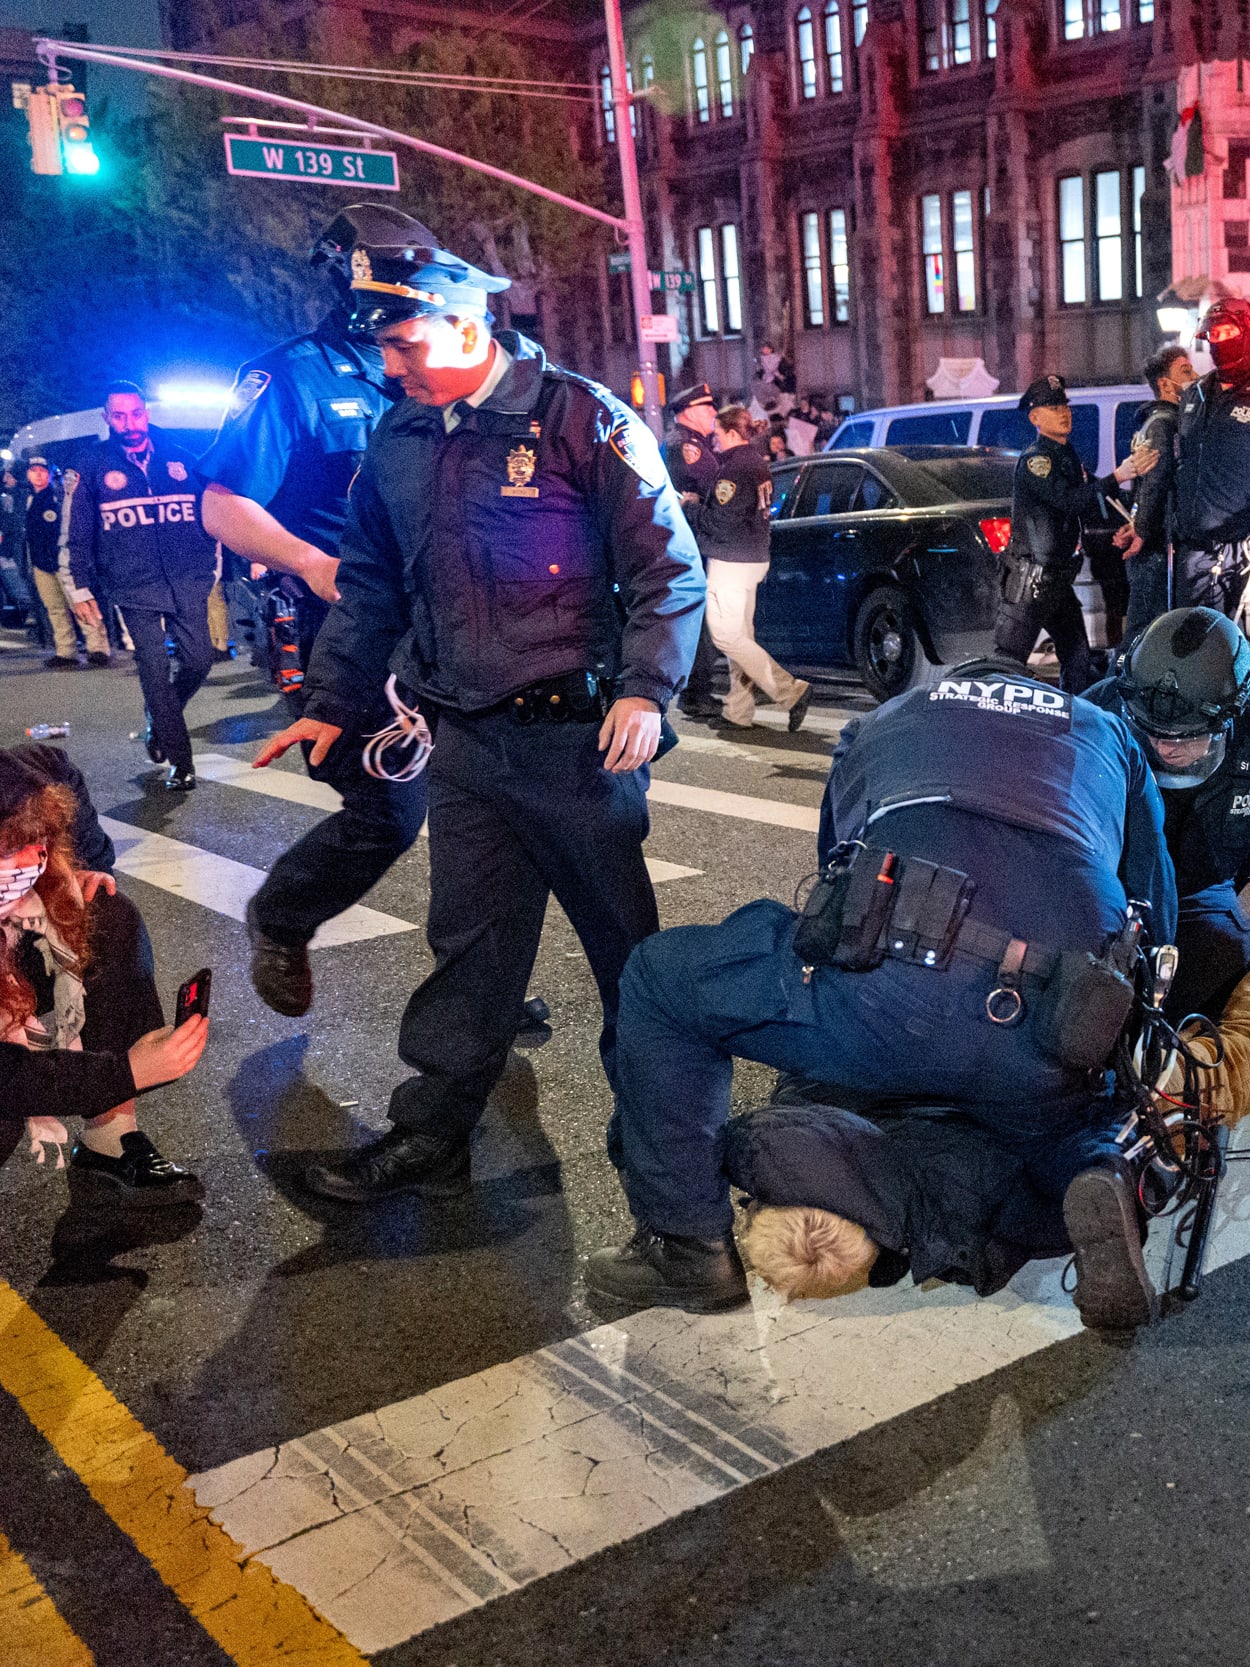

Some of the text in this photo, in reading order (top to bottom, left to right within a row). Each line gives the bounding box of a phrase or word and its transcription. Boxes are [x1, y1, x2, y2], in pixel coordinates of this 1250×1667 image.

[262, 146, 366, 179] W 139 St
[665, 274, 682, 289] 139
[101, 502, 196, 531] POLICE
[929, 692, 1070, 719] STRATEGIC RESPONSE
[937, 681, 1064, 709] NYPD
[977, 702, 1021, 715] GROUP
